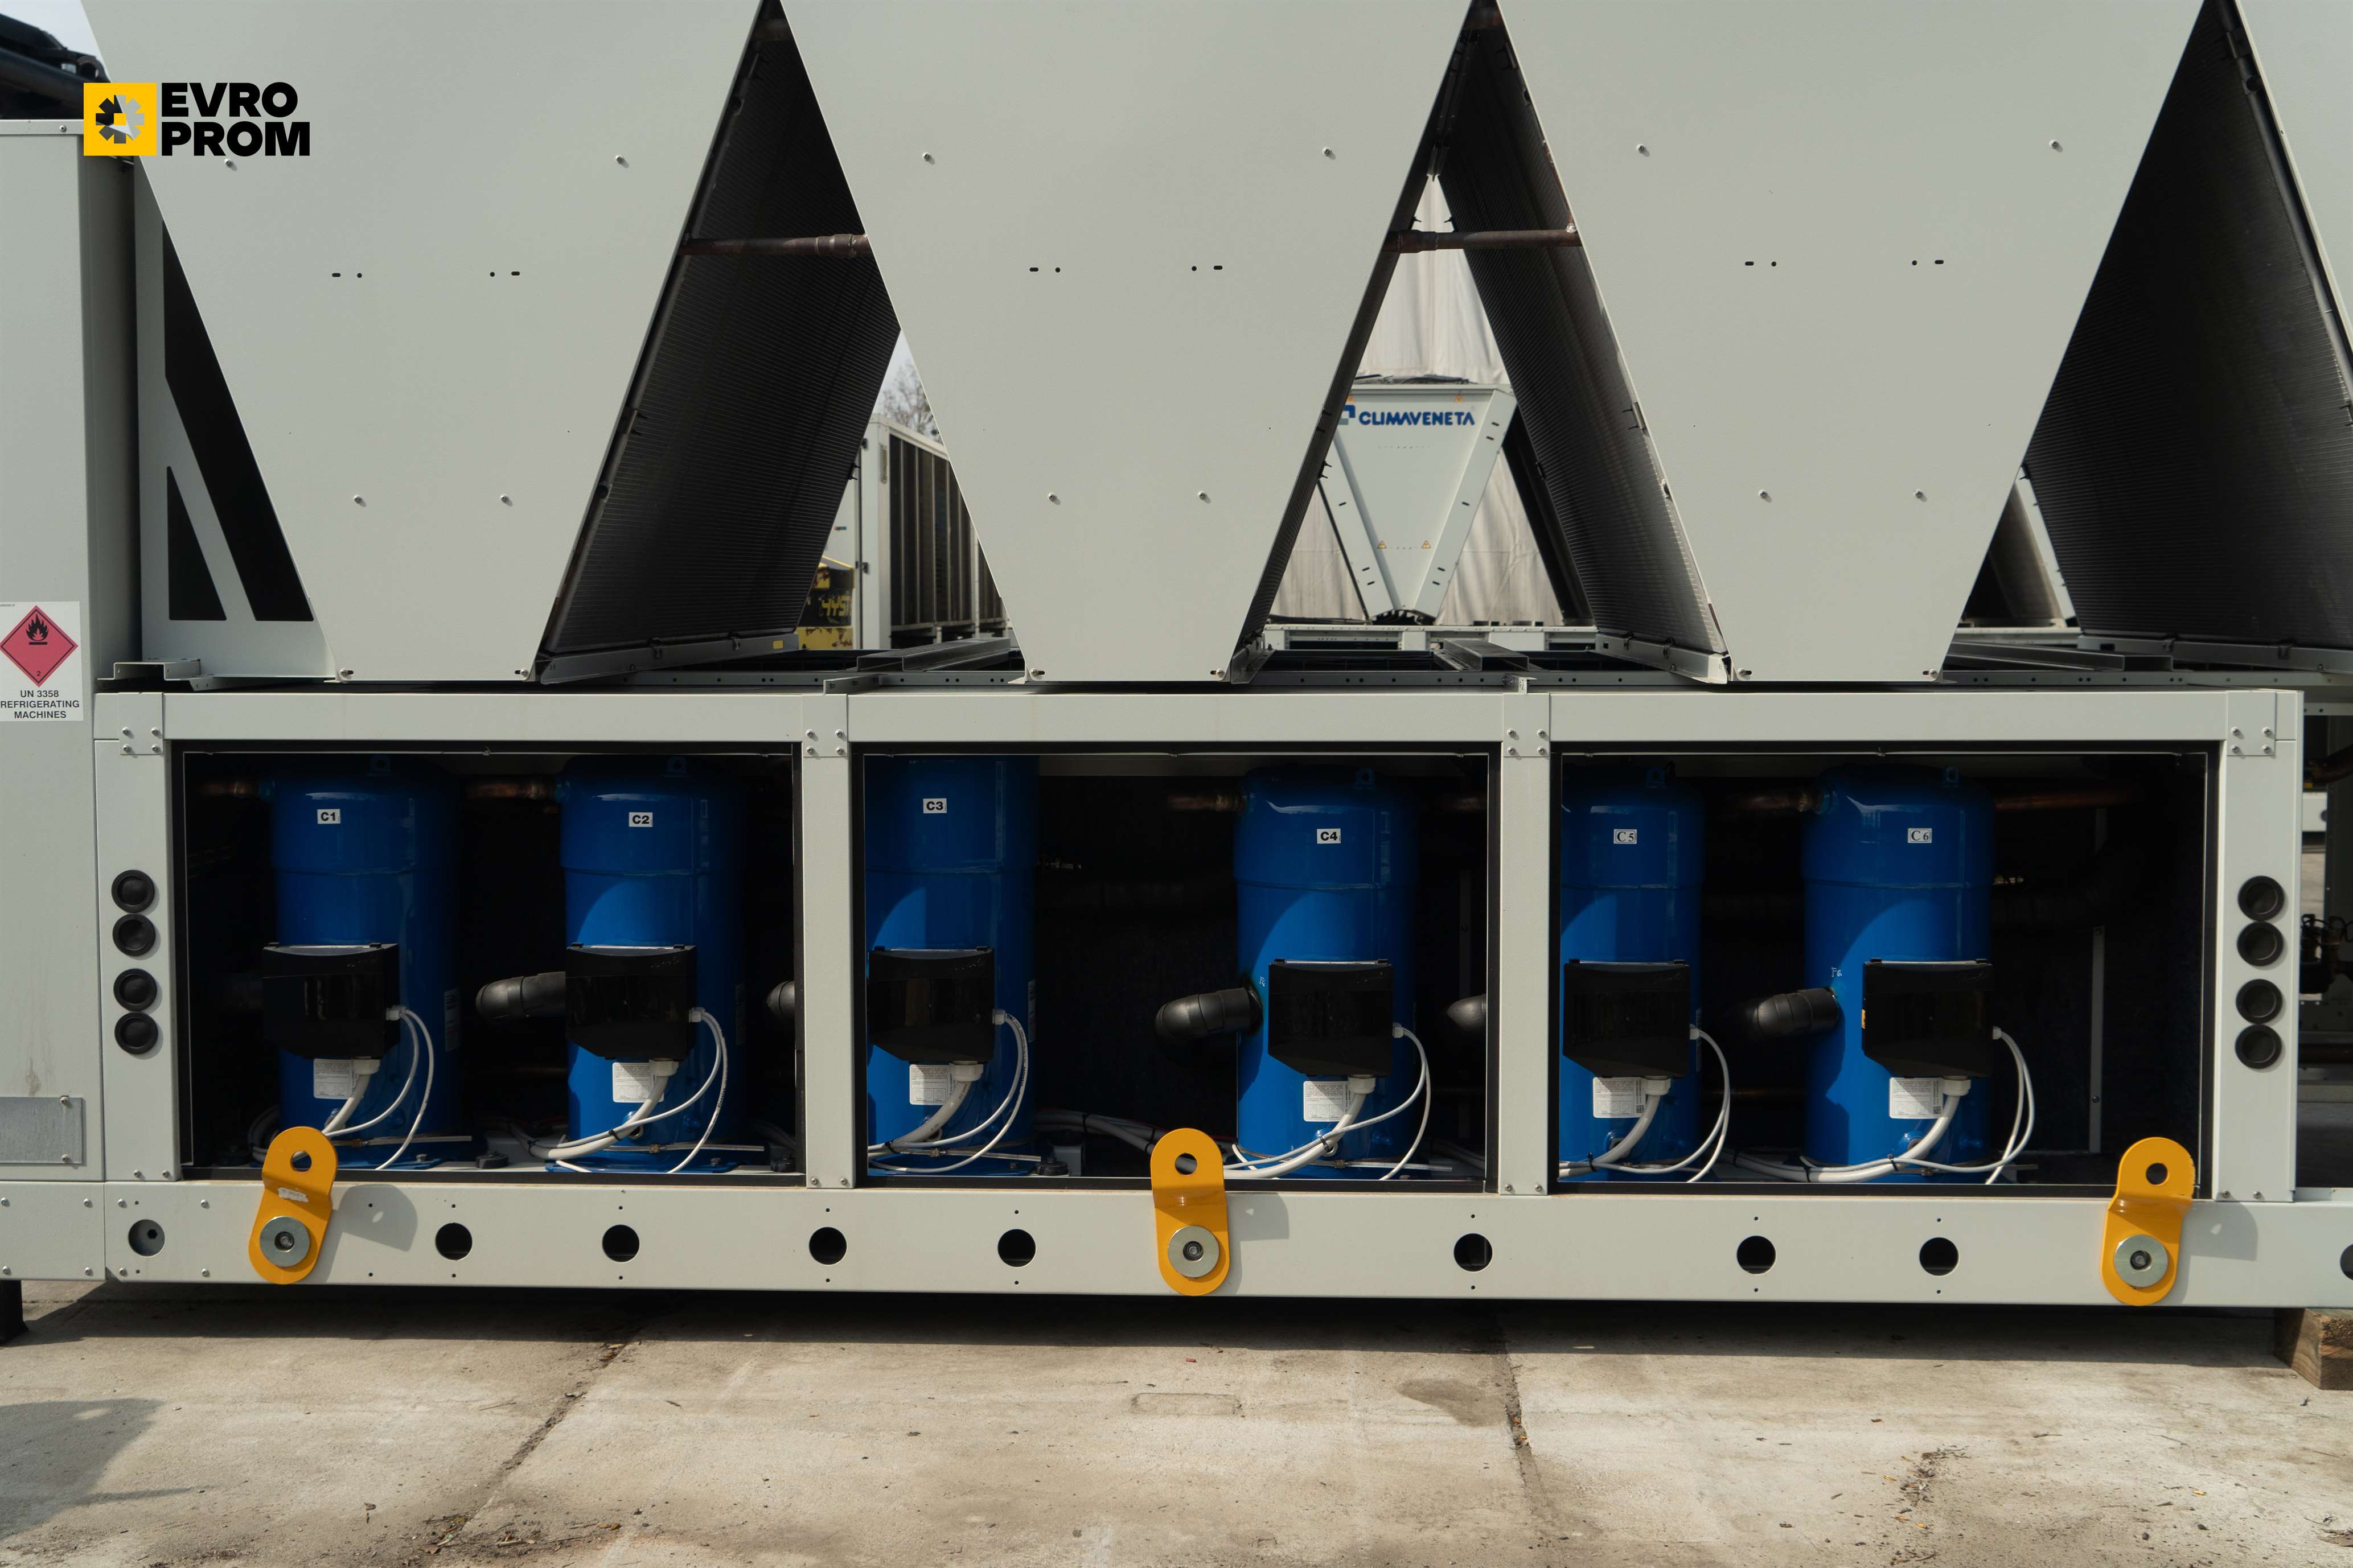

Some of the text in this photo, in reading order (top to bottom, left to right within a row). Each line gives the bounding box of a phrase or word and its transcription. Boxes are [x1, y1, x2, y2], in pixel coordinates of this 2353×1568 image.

[1358, 411, 1475, 425] CLIMAVENETA
[926, 801, 944, 810] C3
[321, 812, 335, 821] C1
[632, 814, 650, 824] C2
[1320, 831, 1338, 841] C4
[1617, 831, 1634, 842] C5
[1911, 830, 1929, 841] C6
